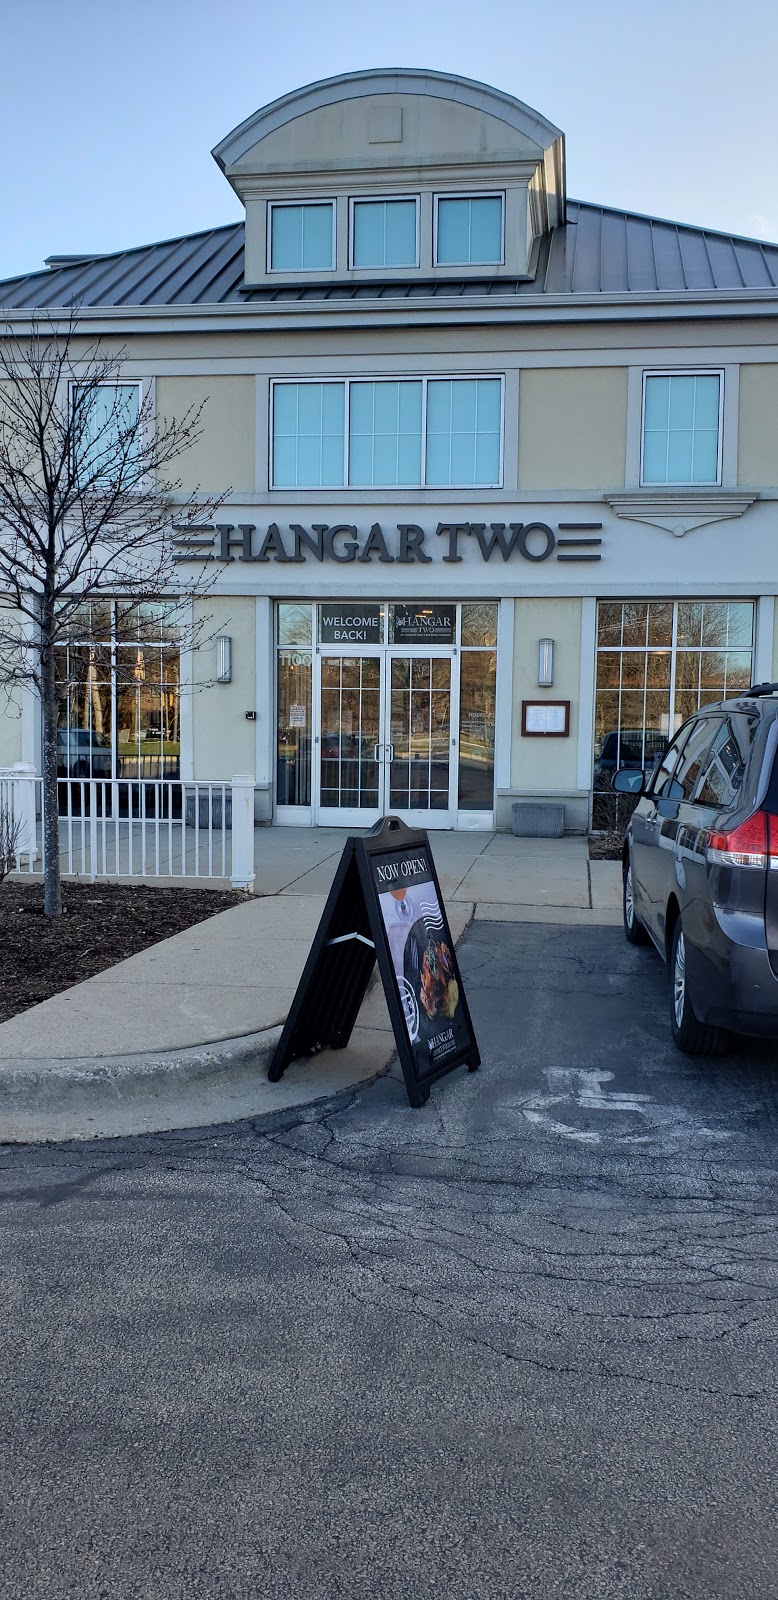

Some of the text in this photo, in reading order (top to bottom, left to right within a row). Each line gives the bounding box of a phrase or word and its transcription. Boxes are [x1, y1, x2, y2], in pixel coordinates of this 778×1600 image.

[215, 522, 555, 563] HANGAR TWO
[323, 617, 379, 627] WELCOME
[402, 616, 451, 627] HANGAR
[334, 630, 367, 640] BACK!
[376, 858, 428, 882] NOW OPEN!
